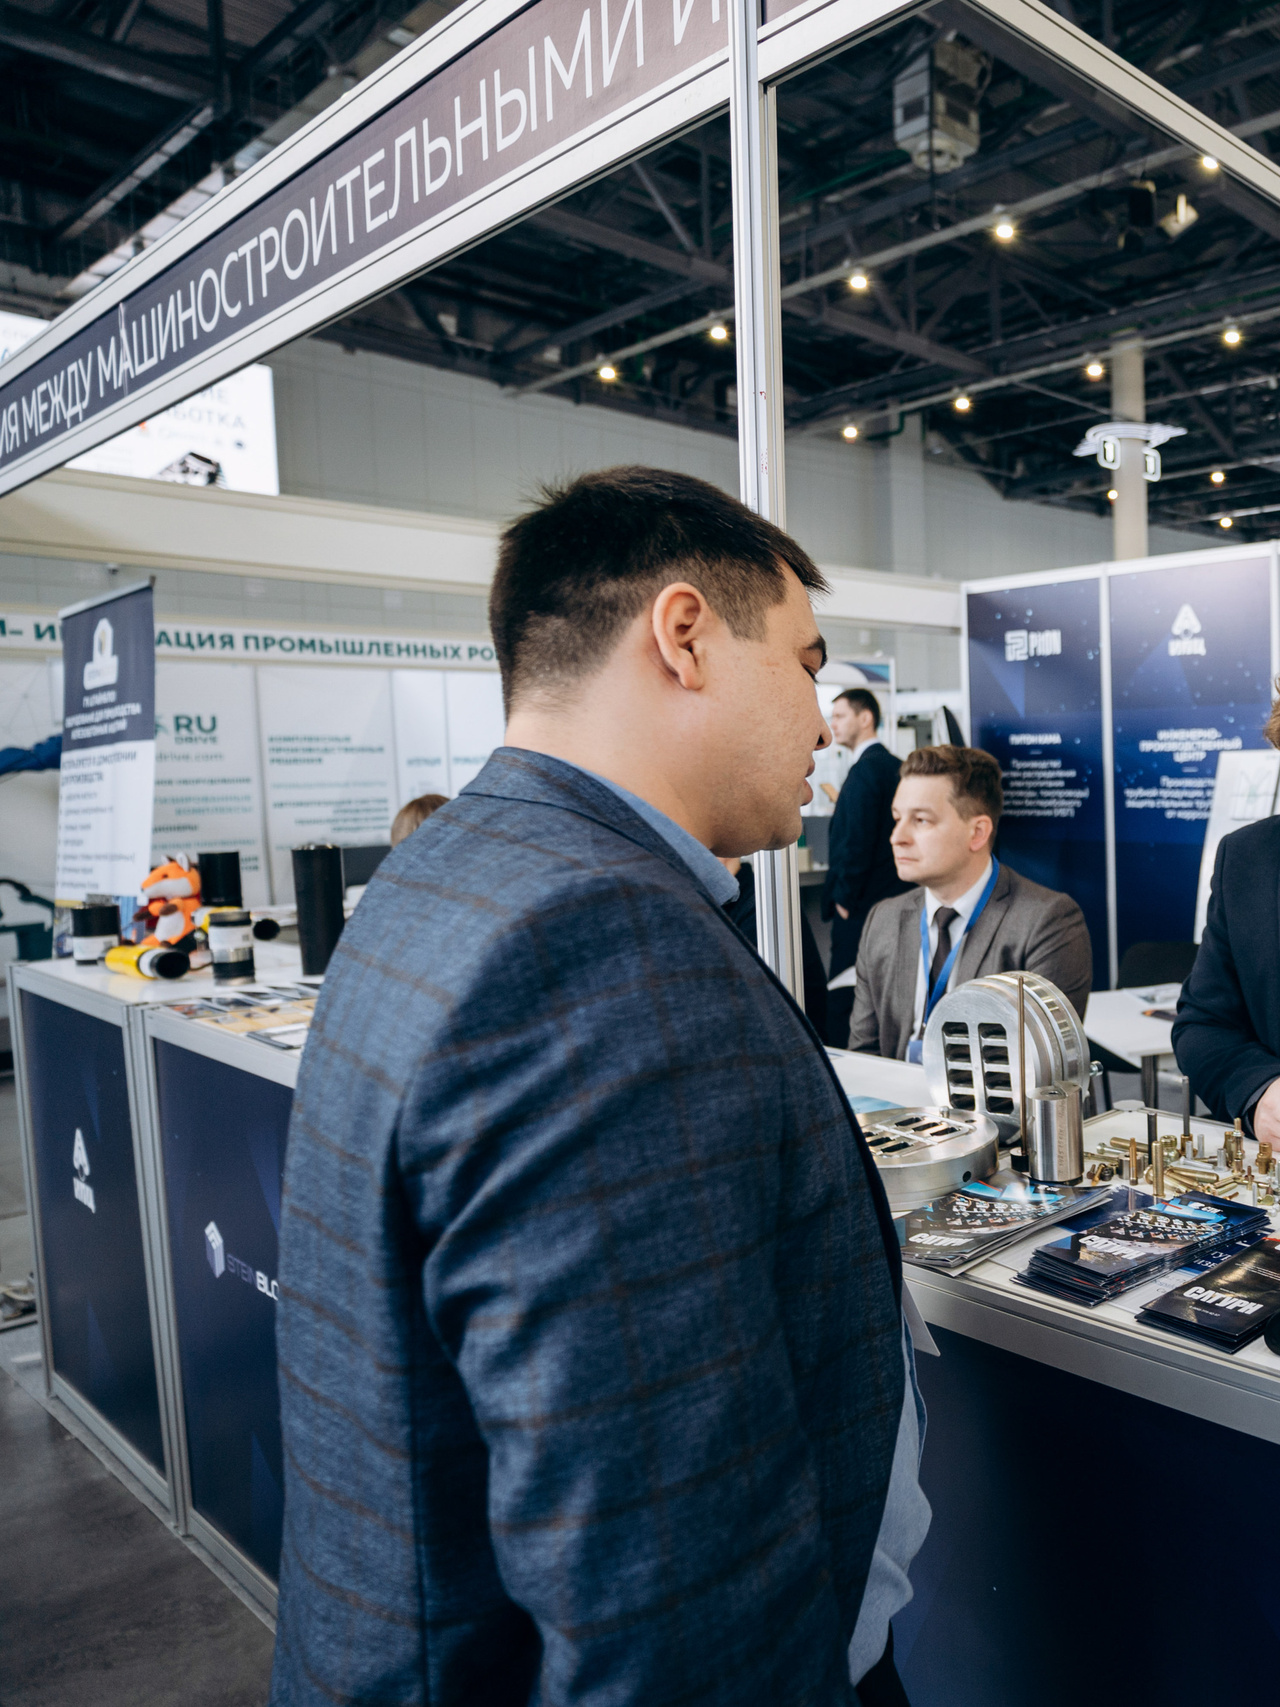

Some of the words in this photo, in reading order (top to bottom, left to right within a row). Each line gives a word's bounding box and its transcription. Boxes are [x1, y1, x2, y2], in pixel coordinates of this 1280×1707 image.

[22, 351, 92, 443] МЕЖДУ
[97, 0, 645, 398] МАШИНОСТРОИТЕЛЬНЫМИ
[243, 634, 462, 660] ПРОМЫШЛЕННЫХ
